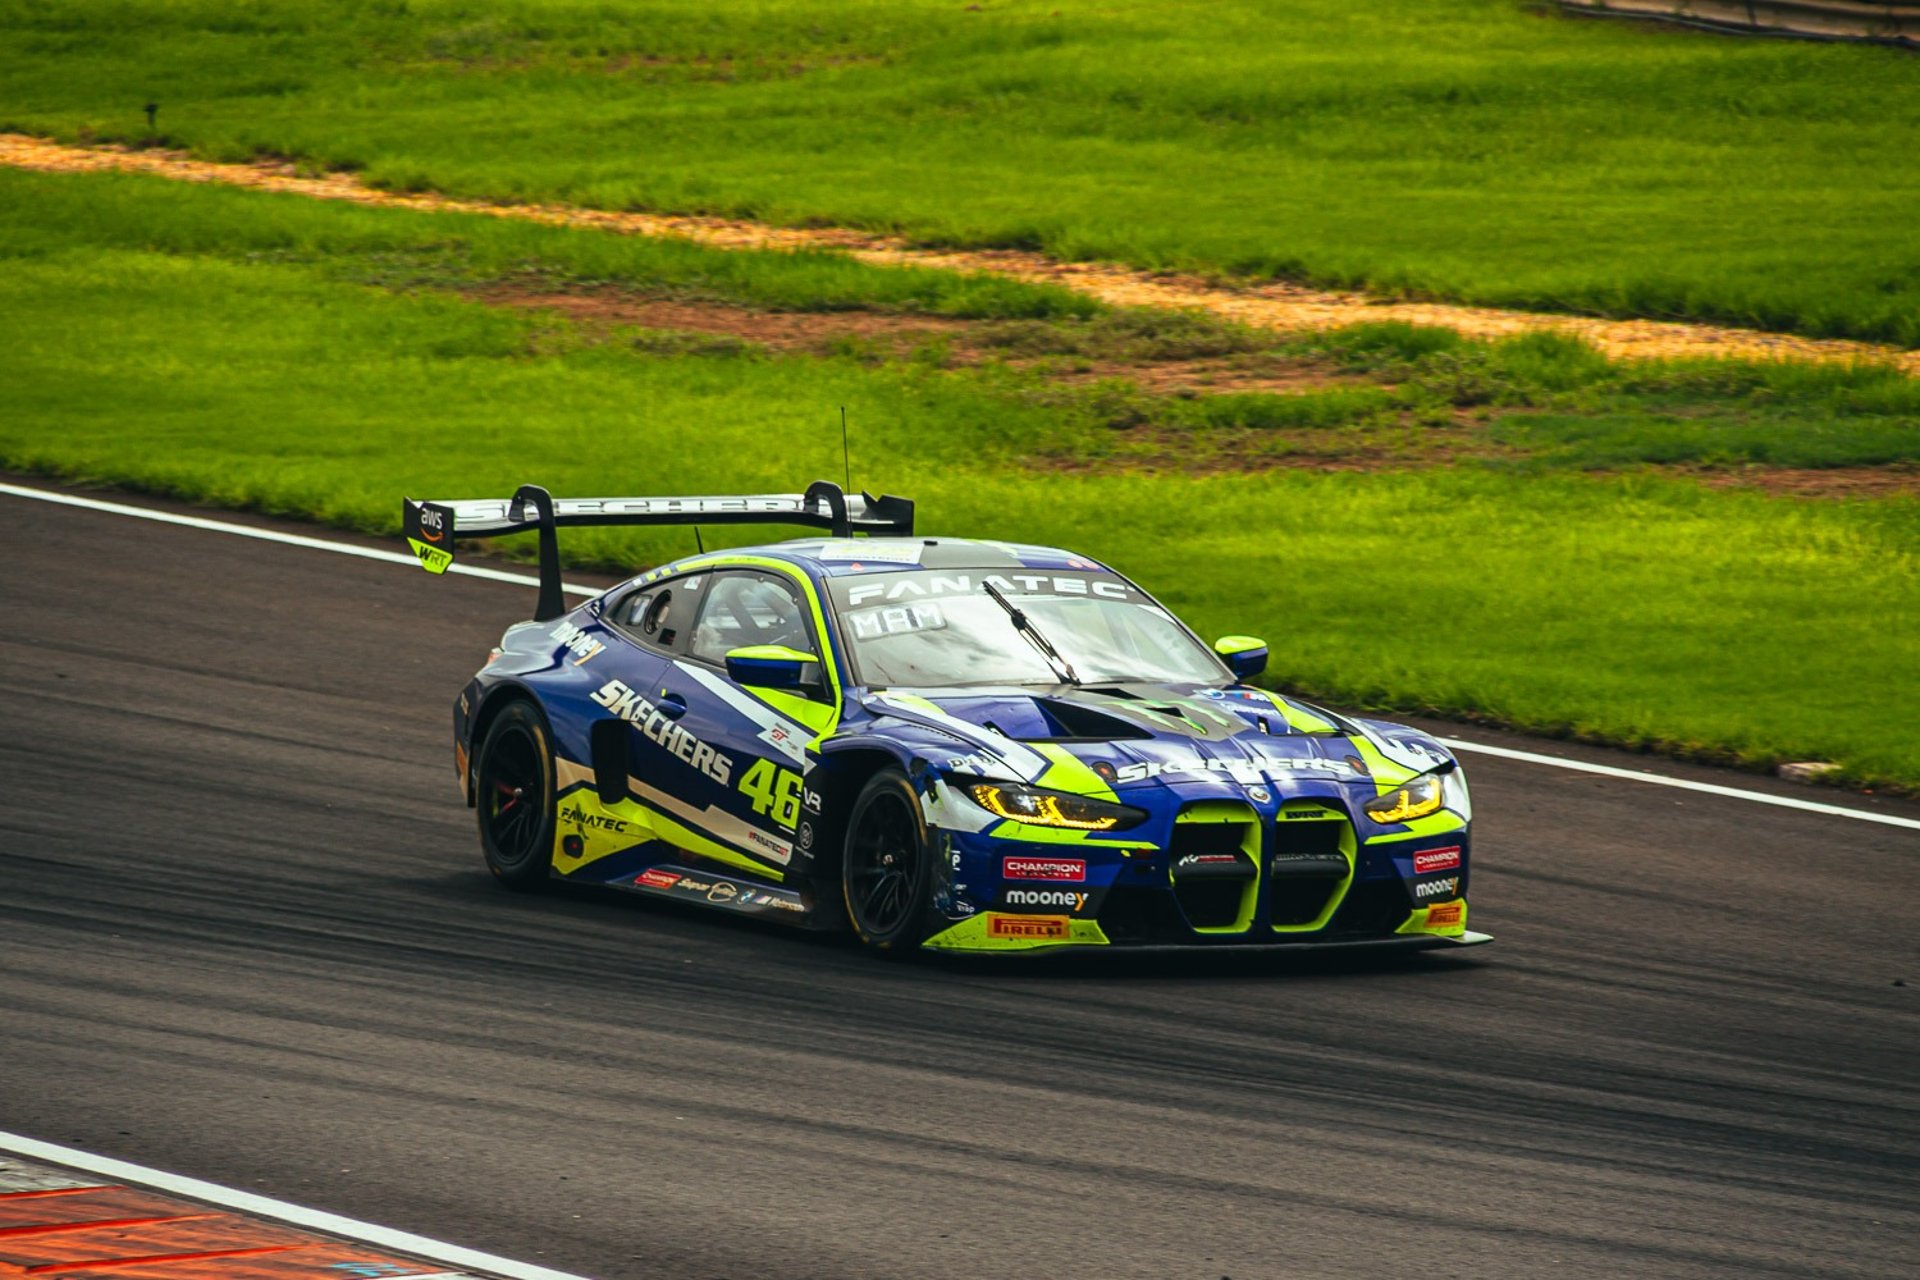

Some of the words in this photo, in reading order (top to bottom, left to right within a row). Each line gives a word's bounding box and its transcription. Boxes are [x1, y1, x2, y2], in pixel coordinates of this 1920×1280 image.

[421, 507, 443, 530] aws
[420, 546, 448, 567] WRT
[848, 574, 1128, 607] FANATEC
[590, 679, 733, 788] SKECHERS
[738, 757, 804, 831] 46
[561, 807, 628, 832] FANATEC
[1007, 861, 1082, 873] CHAMPION
[1416, 876, 1459, 897] mooney
[1007, 890, 1089, 912] mooney
[994, 918, 1063, 936] PIRELLI
